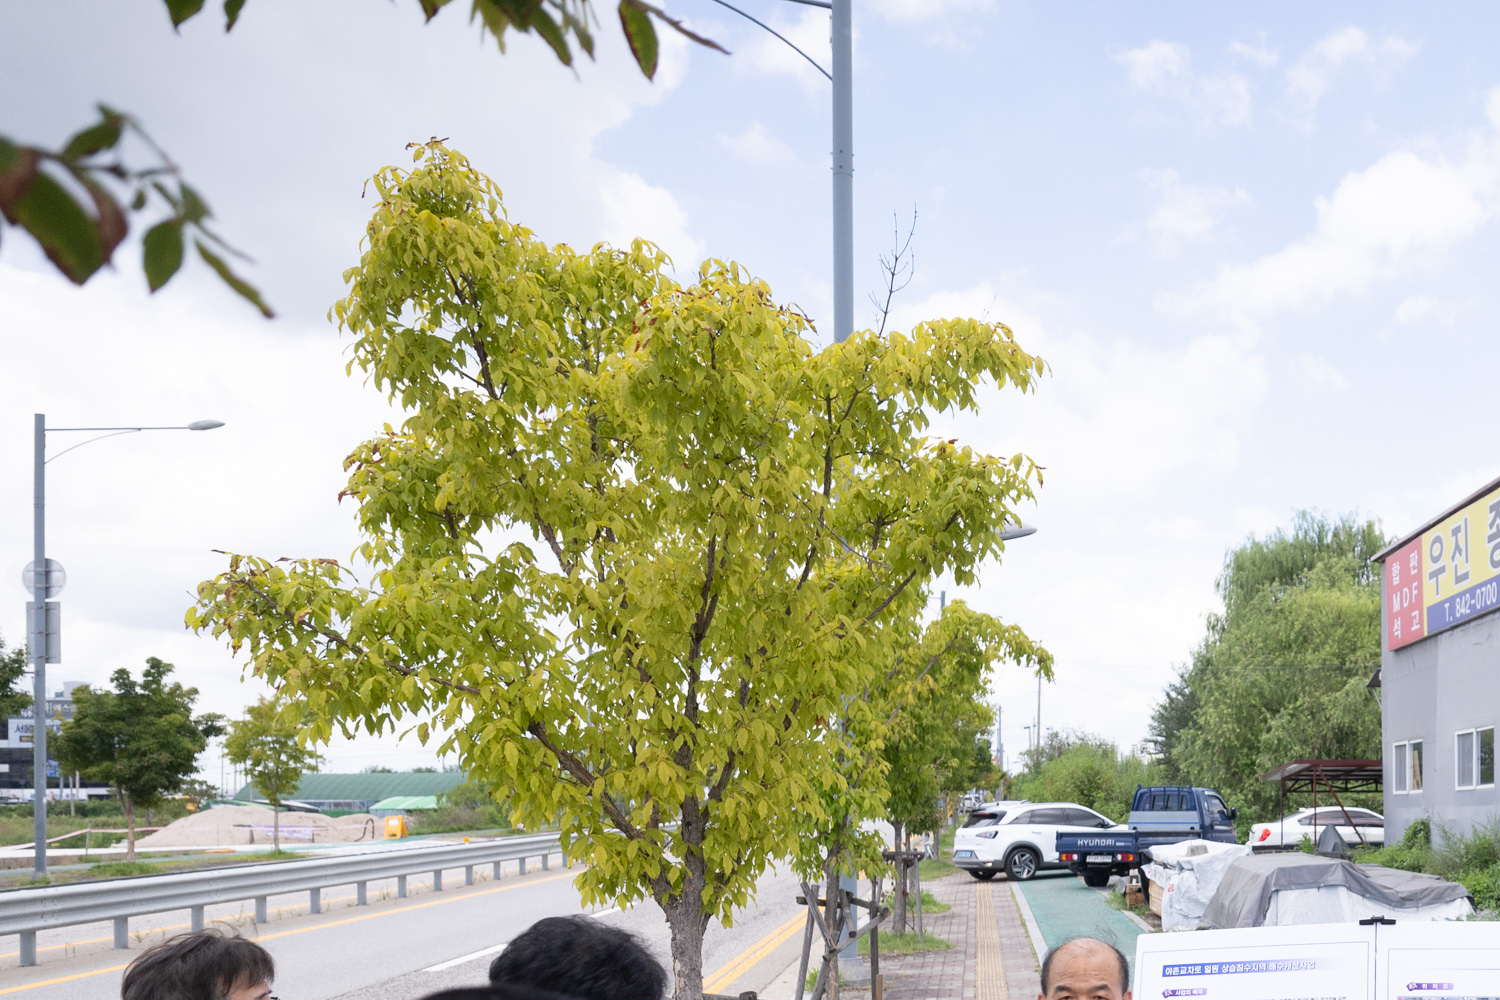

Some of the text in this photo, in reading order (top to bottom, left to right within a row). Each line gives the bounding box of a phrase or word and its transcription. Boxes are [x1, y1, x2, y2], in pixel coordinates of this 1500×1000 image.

[1427, 516, 1470, 597] 우진
[1444, 602, 1453, 623] T.
[1455, 580, 1498, 618] 842-0700
